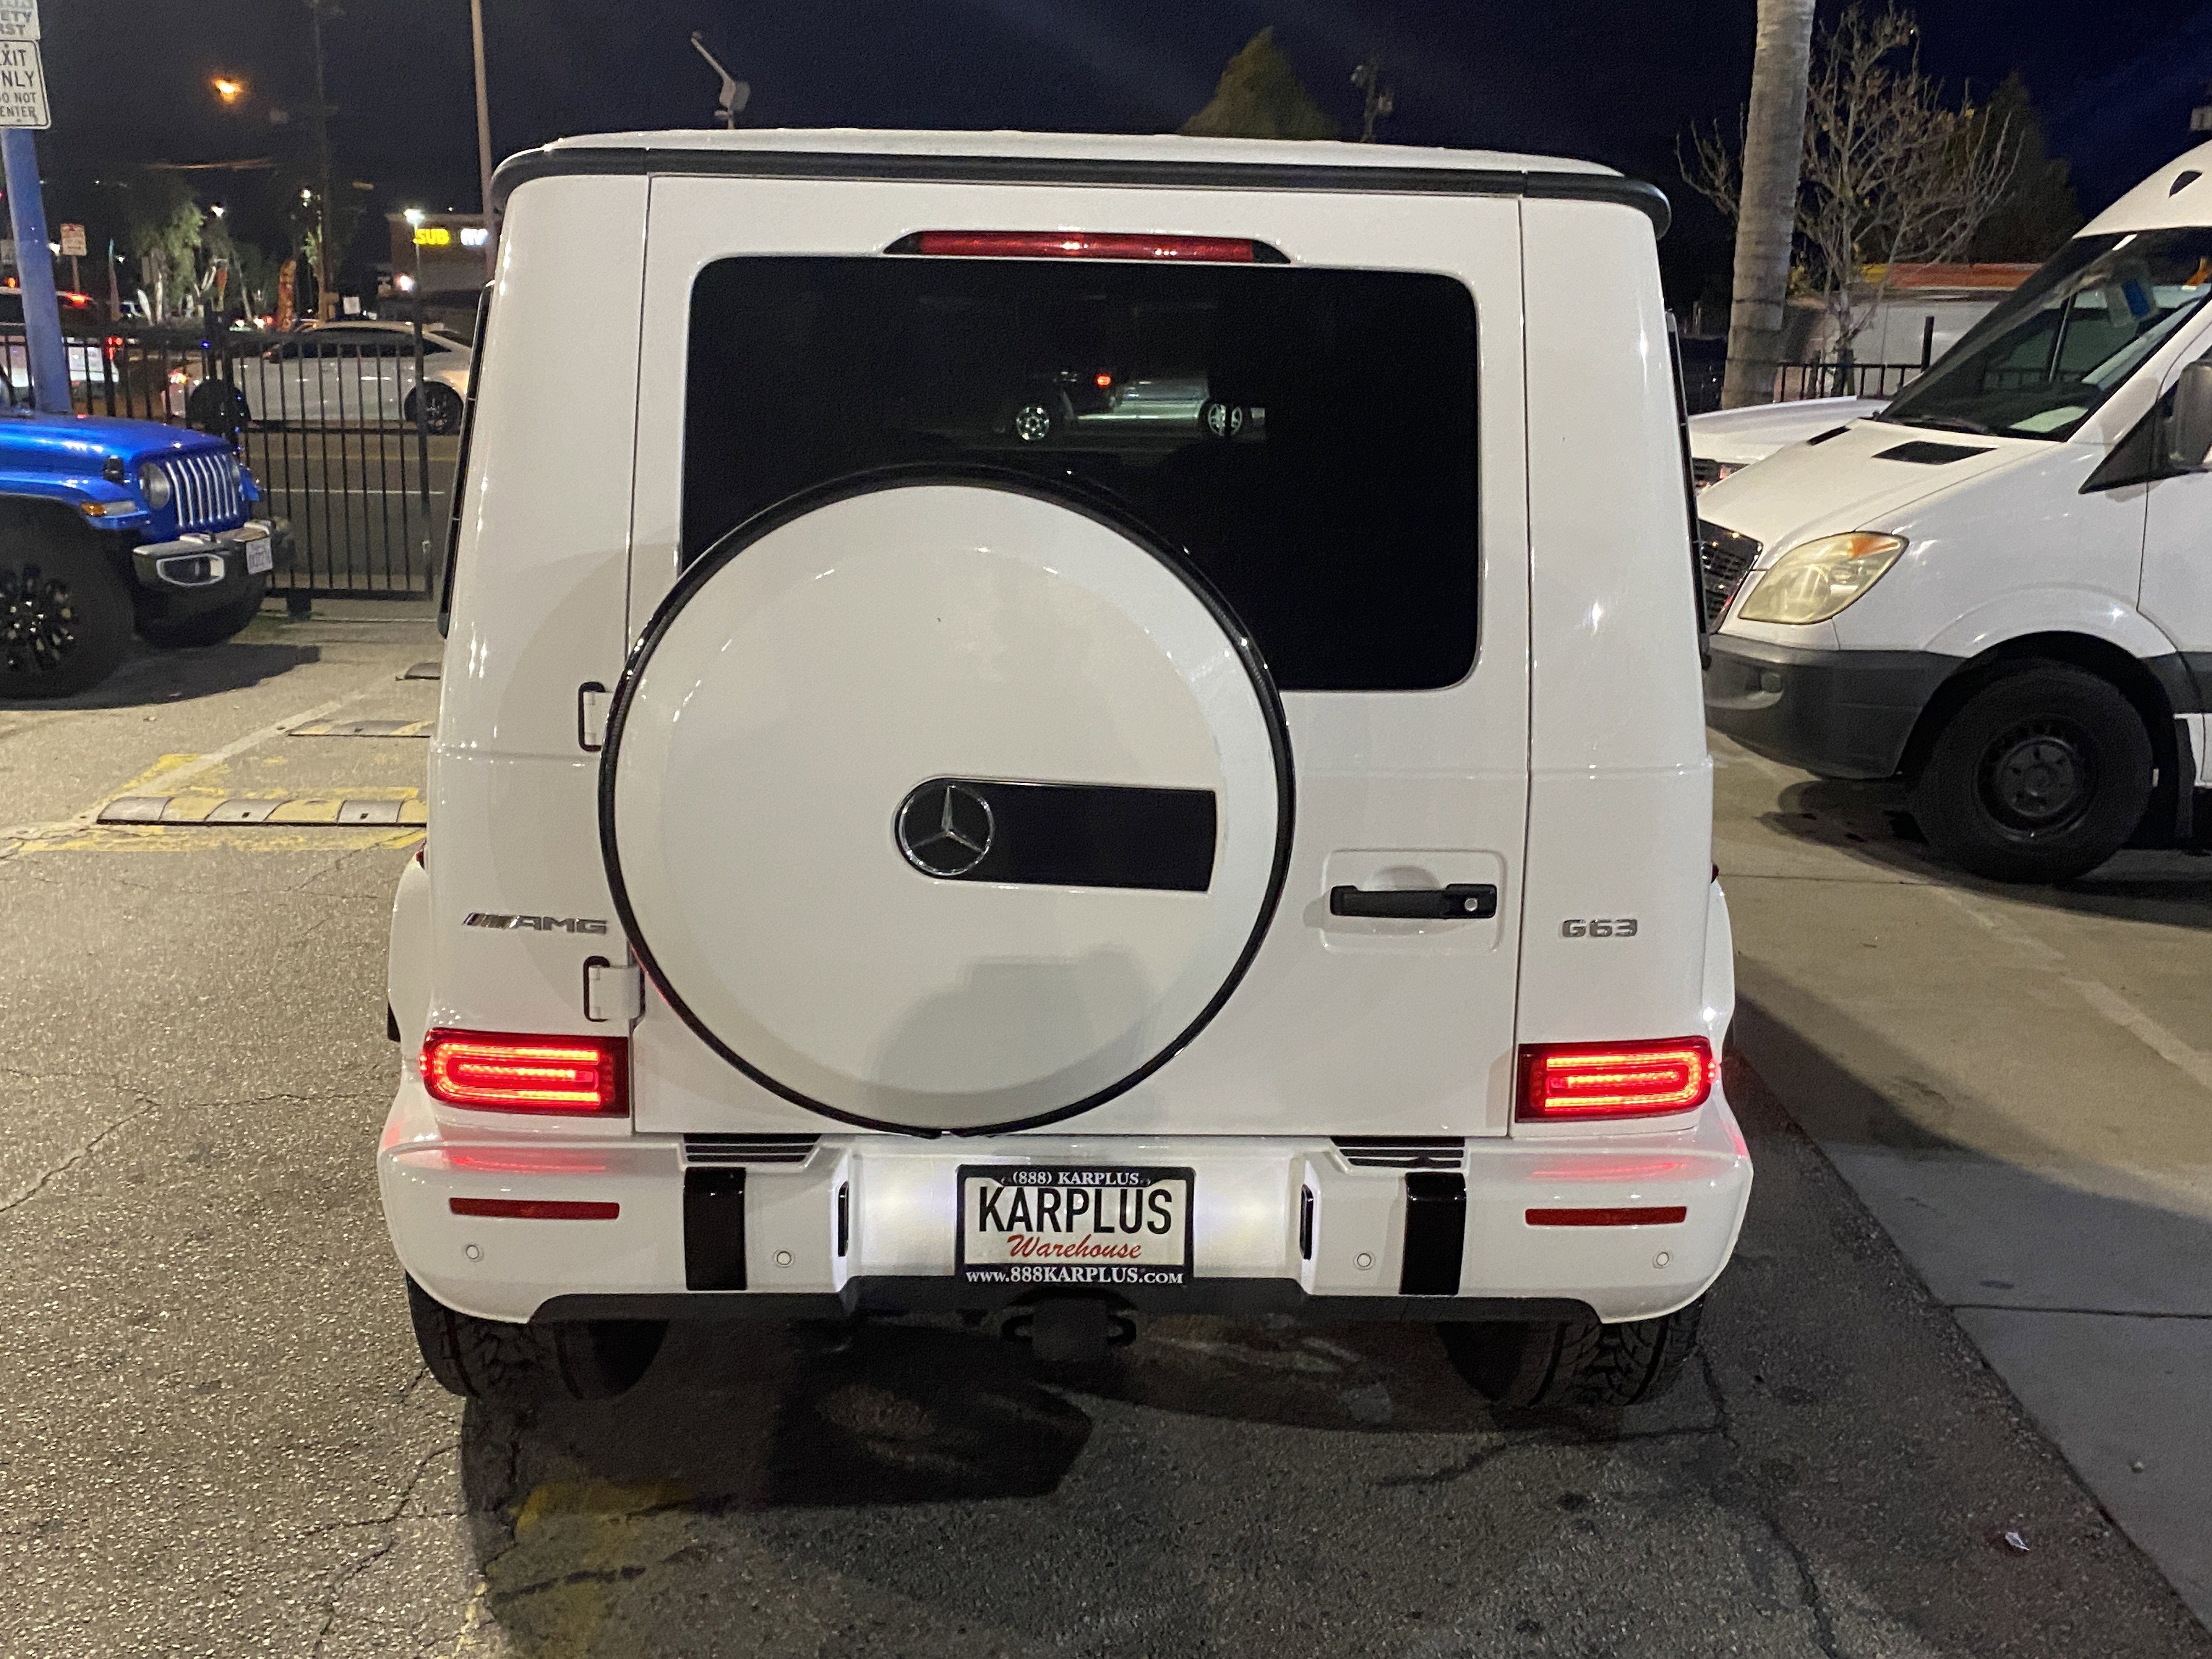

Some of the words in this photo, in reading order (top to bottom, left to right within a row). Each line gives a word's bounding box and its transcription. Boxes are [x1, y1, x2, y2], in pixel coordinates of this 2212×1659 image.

[0, 49, 26, 66] XIT
[0, 70, 33, 87] NLY
[14, 92, 36, 103] NOT
[0, 106, 36, 117] ENTER
[510, 915, 607, 933] AMG
[1562, 918, 1638, 937] G63
[1013, 1171, 1052, 1185] (888)
[1058, 1172, 1139, 1186] KARPLUS
[979, 1186, 1172, 1235] KARPLUS
[1006, 1234, 1142, 1259] Warehouse
